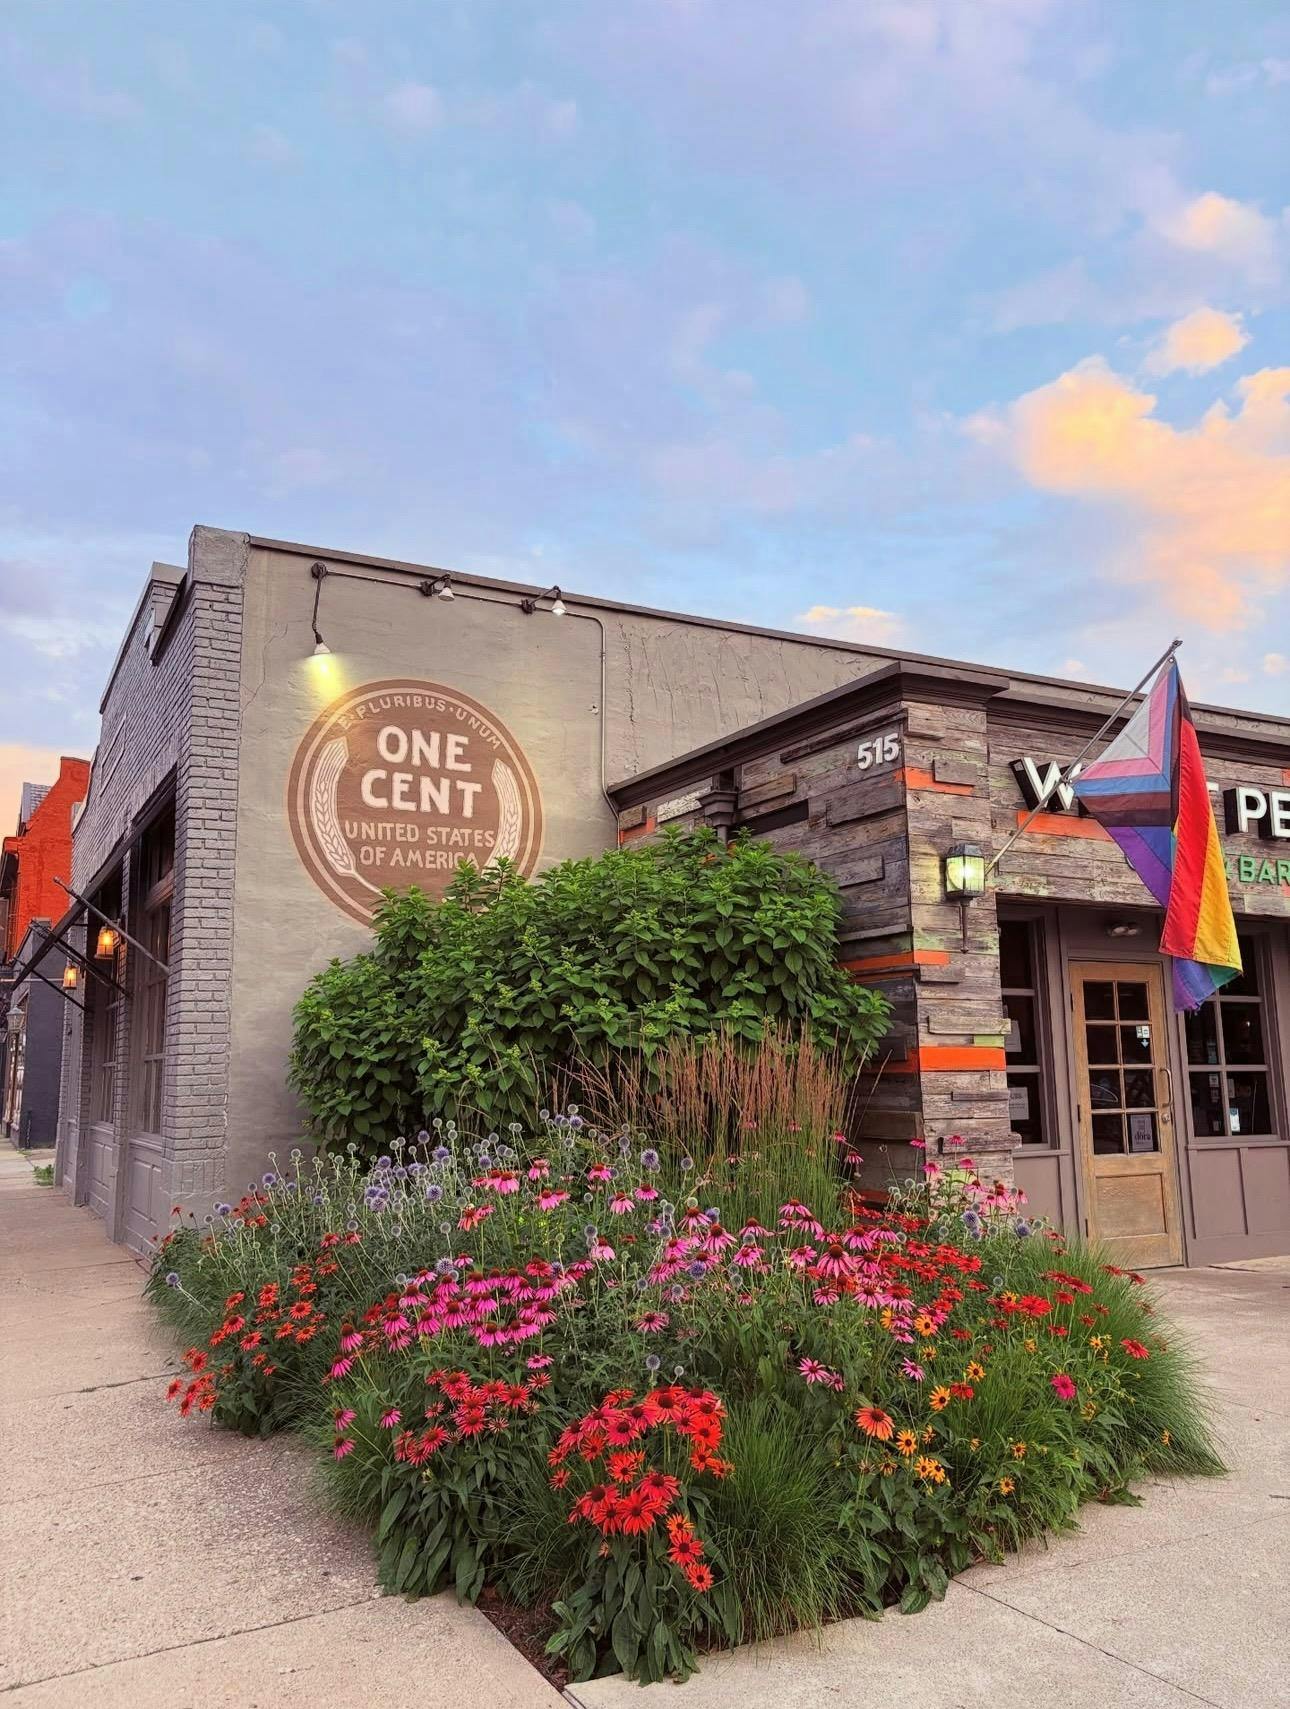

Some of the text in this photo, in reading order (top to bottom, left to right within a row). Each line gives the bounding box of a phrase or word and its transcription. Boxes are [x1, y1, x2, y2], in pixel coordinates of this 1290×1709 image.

[376, 725, 472, 772] ONE
[455, 710, 502, 750] UNUM
[856, 732, 900, 770] 515
[360, 768, 482, 818] CENT
[344, 820, 495, 848] UNITED STATES
[359, 845, 479, 870] OF AMERICA
